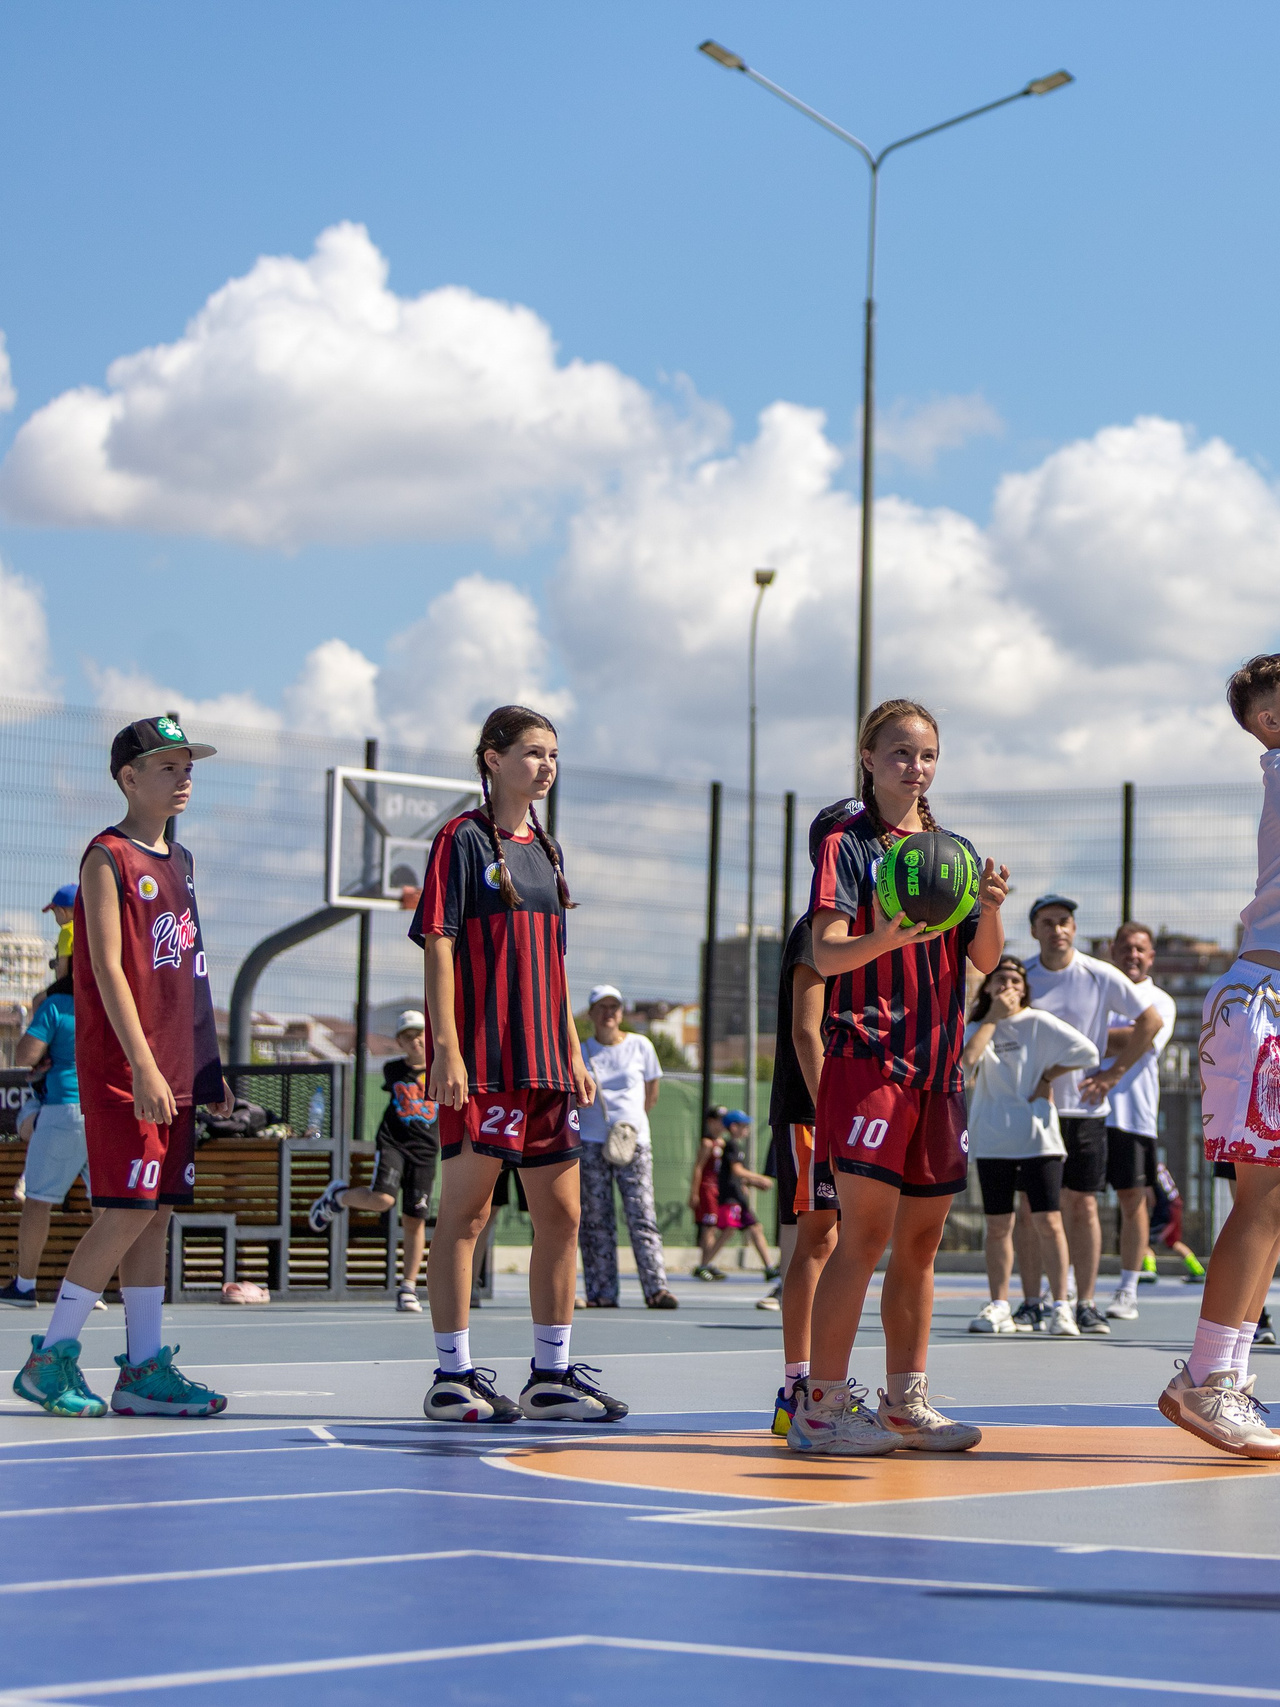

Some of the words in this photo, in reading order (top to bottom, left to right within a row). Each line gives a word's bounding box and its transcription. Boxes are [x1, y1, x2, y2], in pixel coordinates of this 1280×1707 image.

[481, 1105, 524, 1136] 22
[847, 1115, 889, 1149] 10
[127, 1158, 160, 1189] 10
